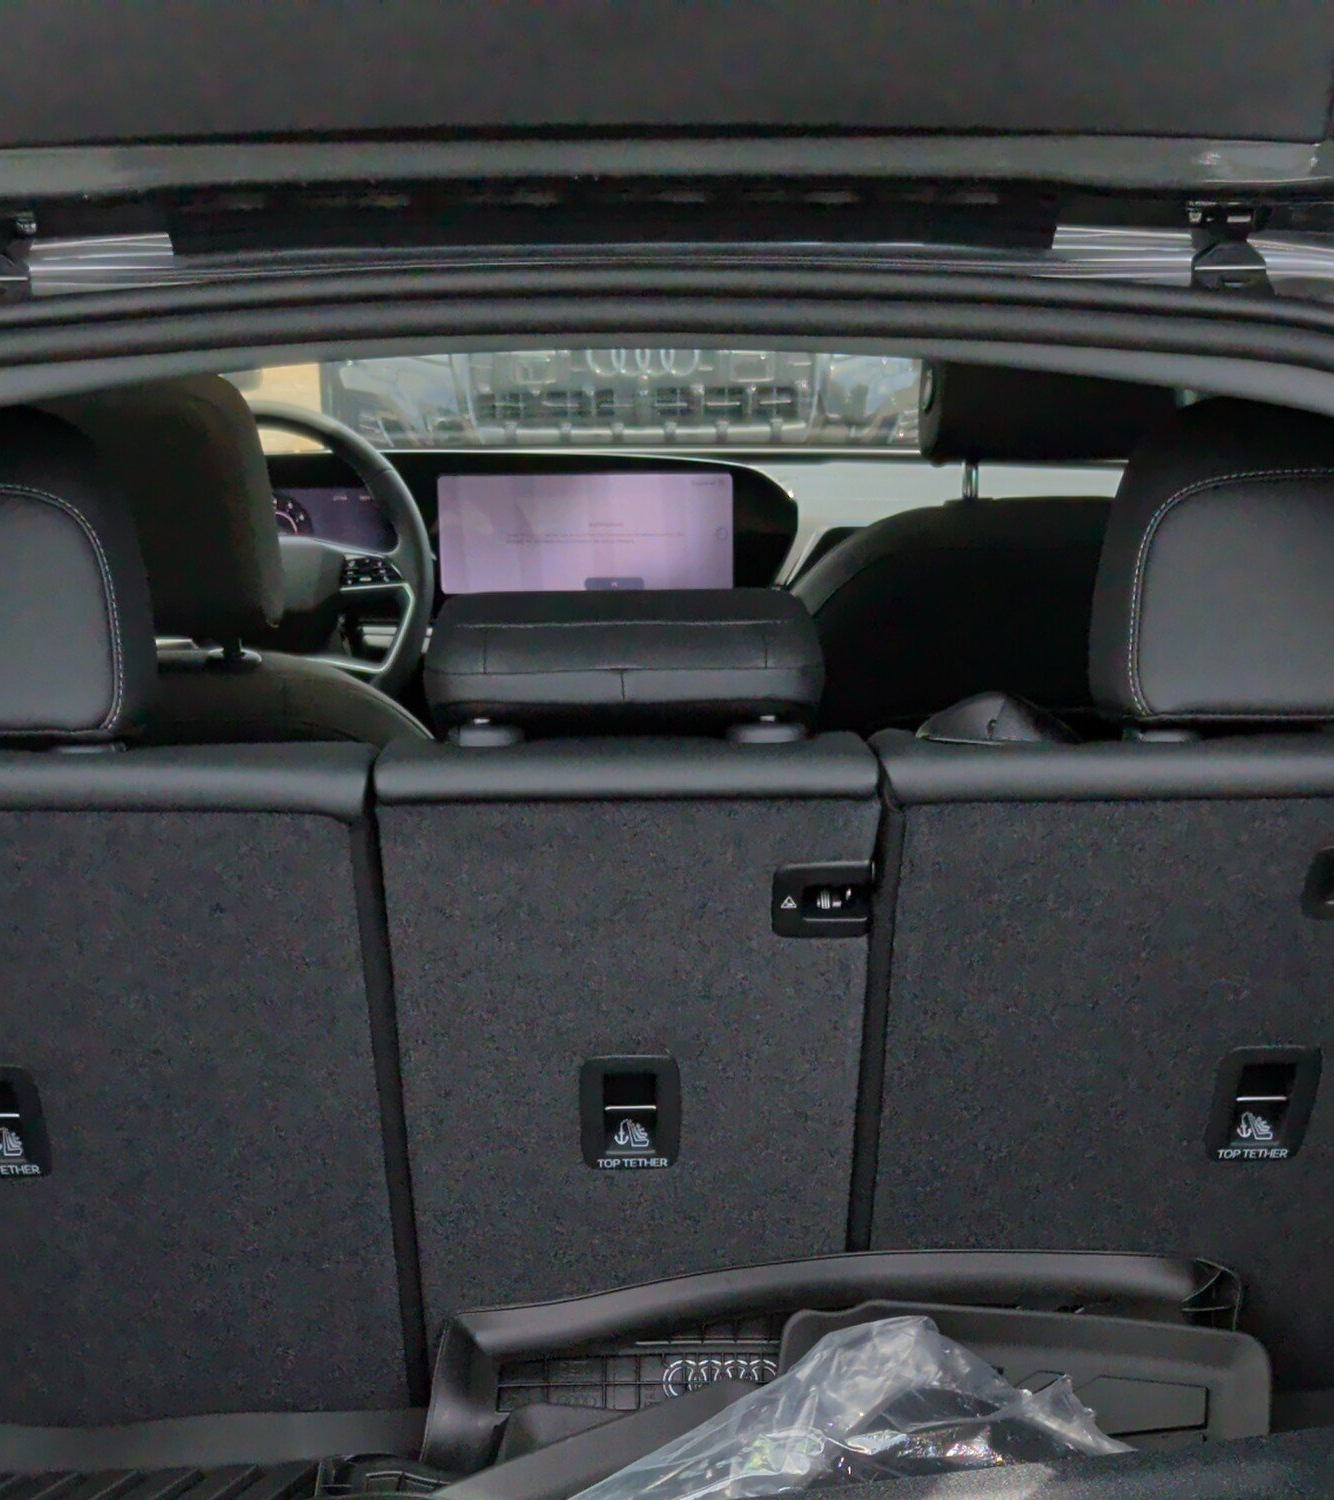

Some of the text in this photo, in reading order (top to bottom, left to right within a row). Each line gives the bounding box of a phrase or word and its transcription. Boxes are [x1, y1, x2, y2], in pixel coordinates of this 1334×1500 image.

[1217, 1148, 1288, 1159] TOP TETHER
[597, 1157, 668, 1168] TOP TETHER
